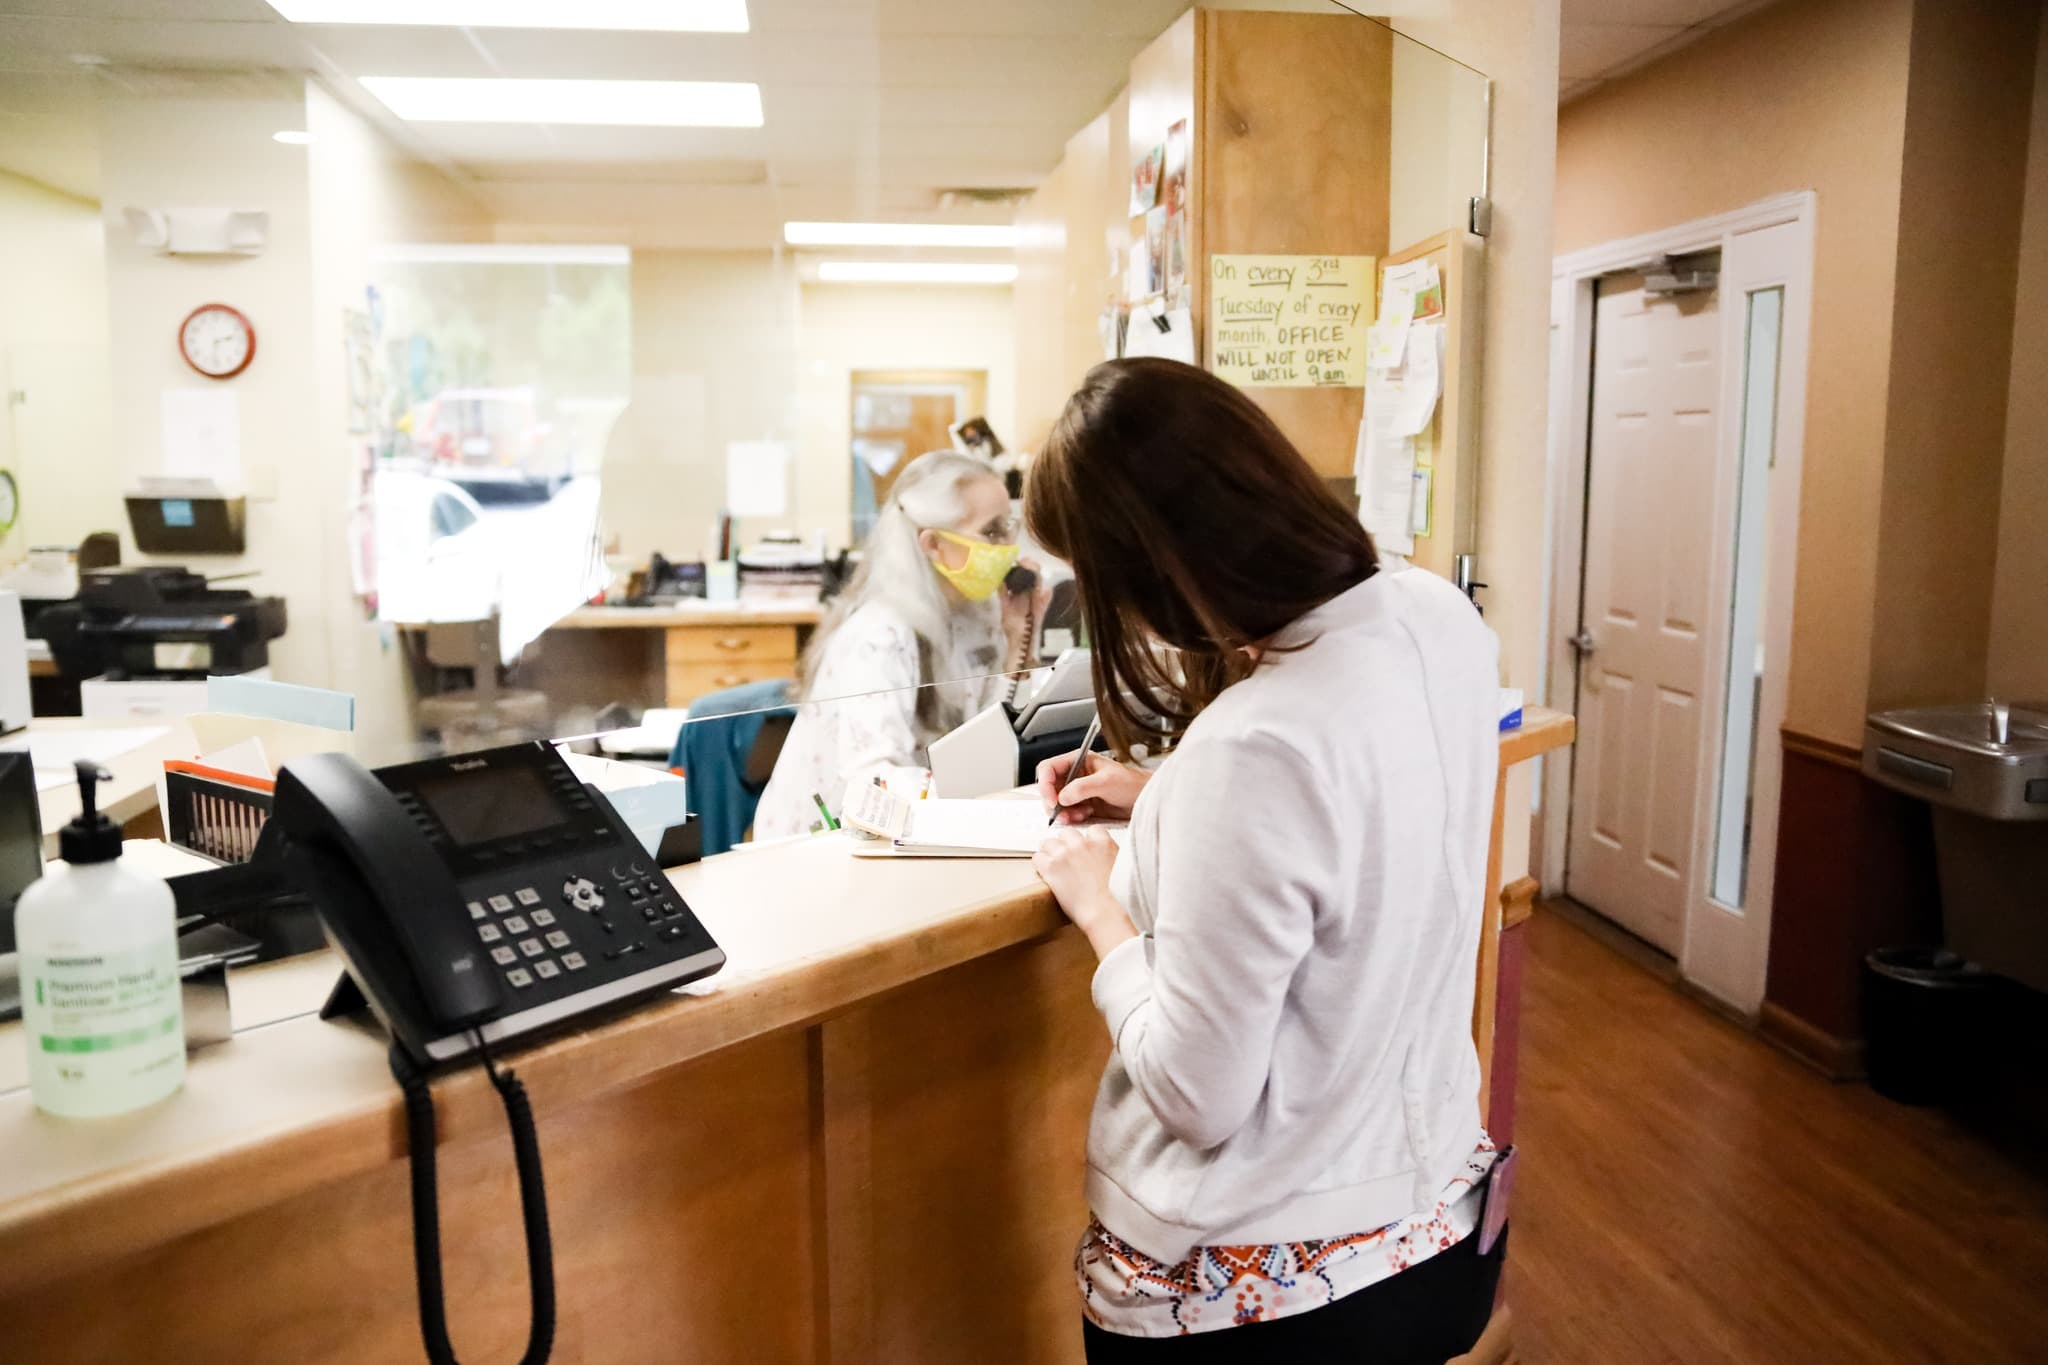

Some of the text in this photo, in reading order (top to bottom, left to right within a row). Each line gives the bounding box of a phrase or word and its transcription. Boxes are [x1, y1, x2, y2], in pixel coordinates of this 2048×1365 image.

[1214, 258, 1236, 280] On
[1248, 266, 1297, 291] every
[1216, 297, 1284, 326] Tuesday
[1294, 294, 1312, 314] of
[1278, 325, 1344, 345] OFFICE
[1216, 347, 1351, 367] WILL NOT OPEN
[1251, 367, 1299, 381] UNTIL
